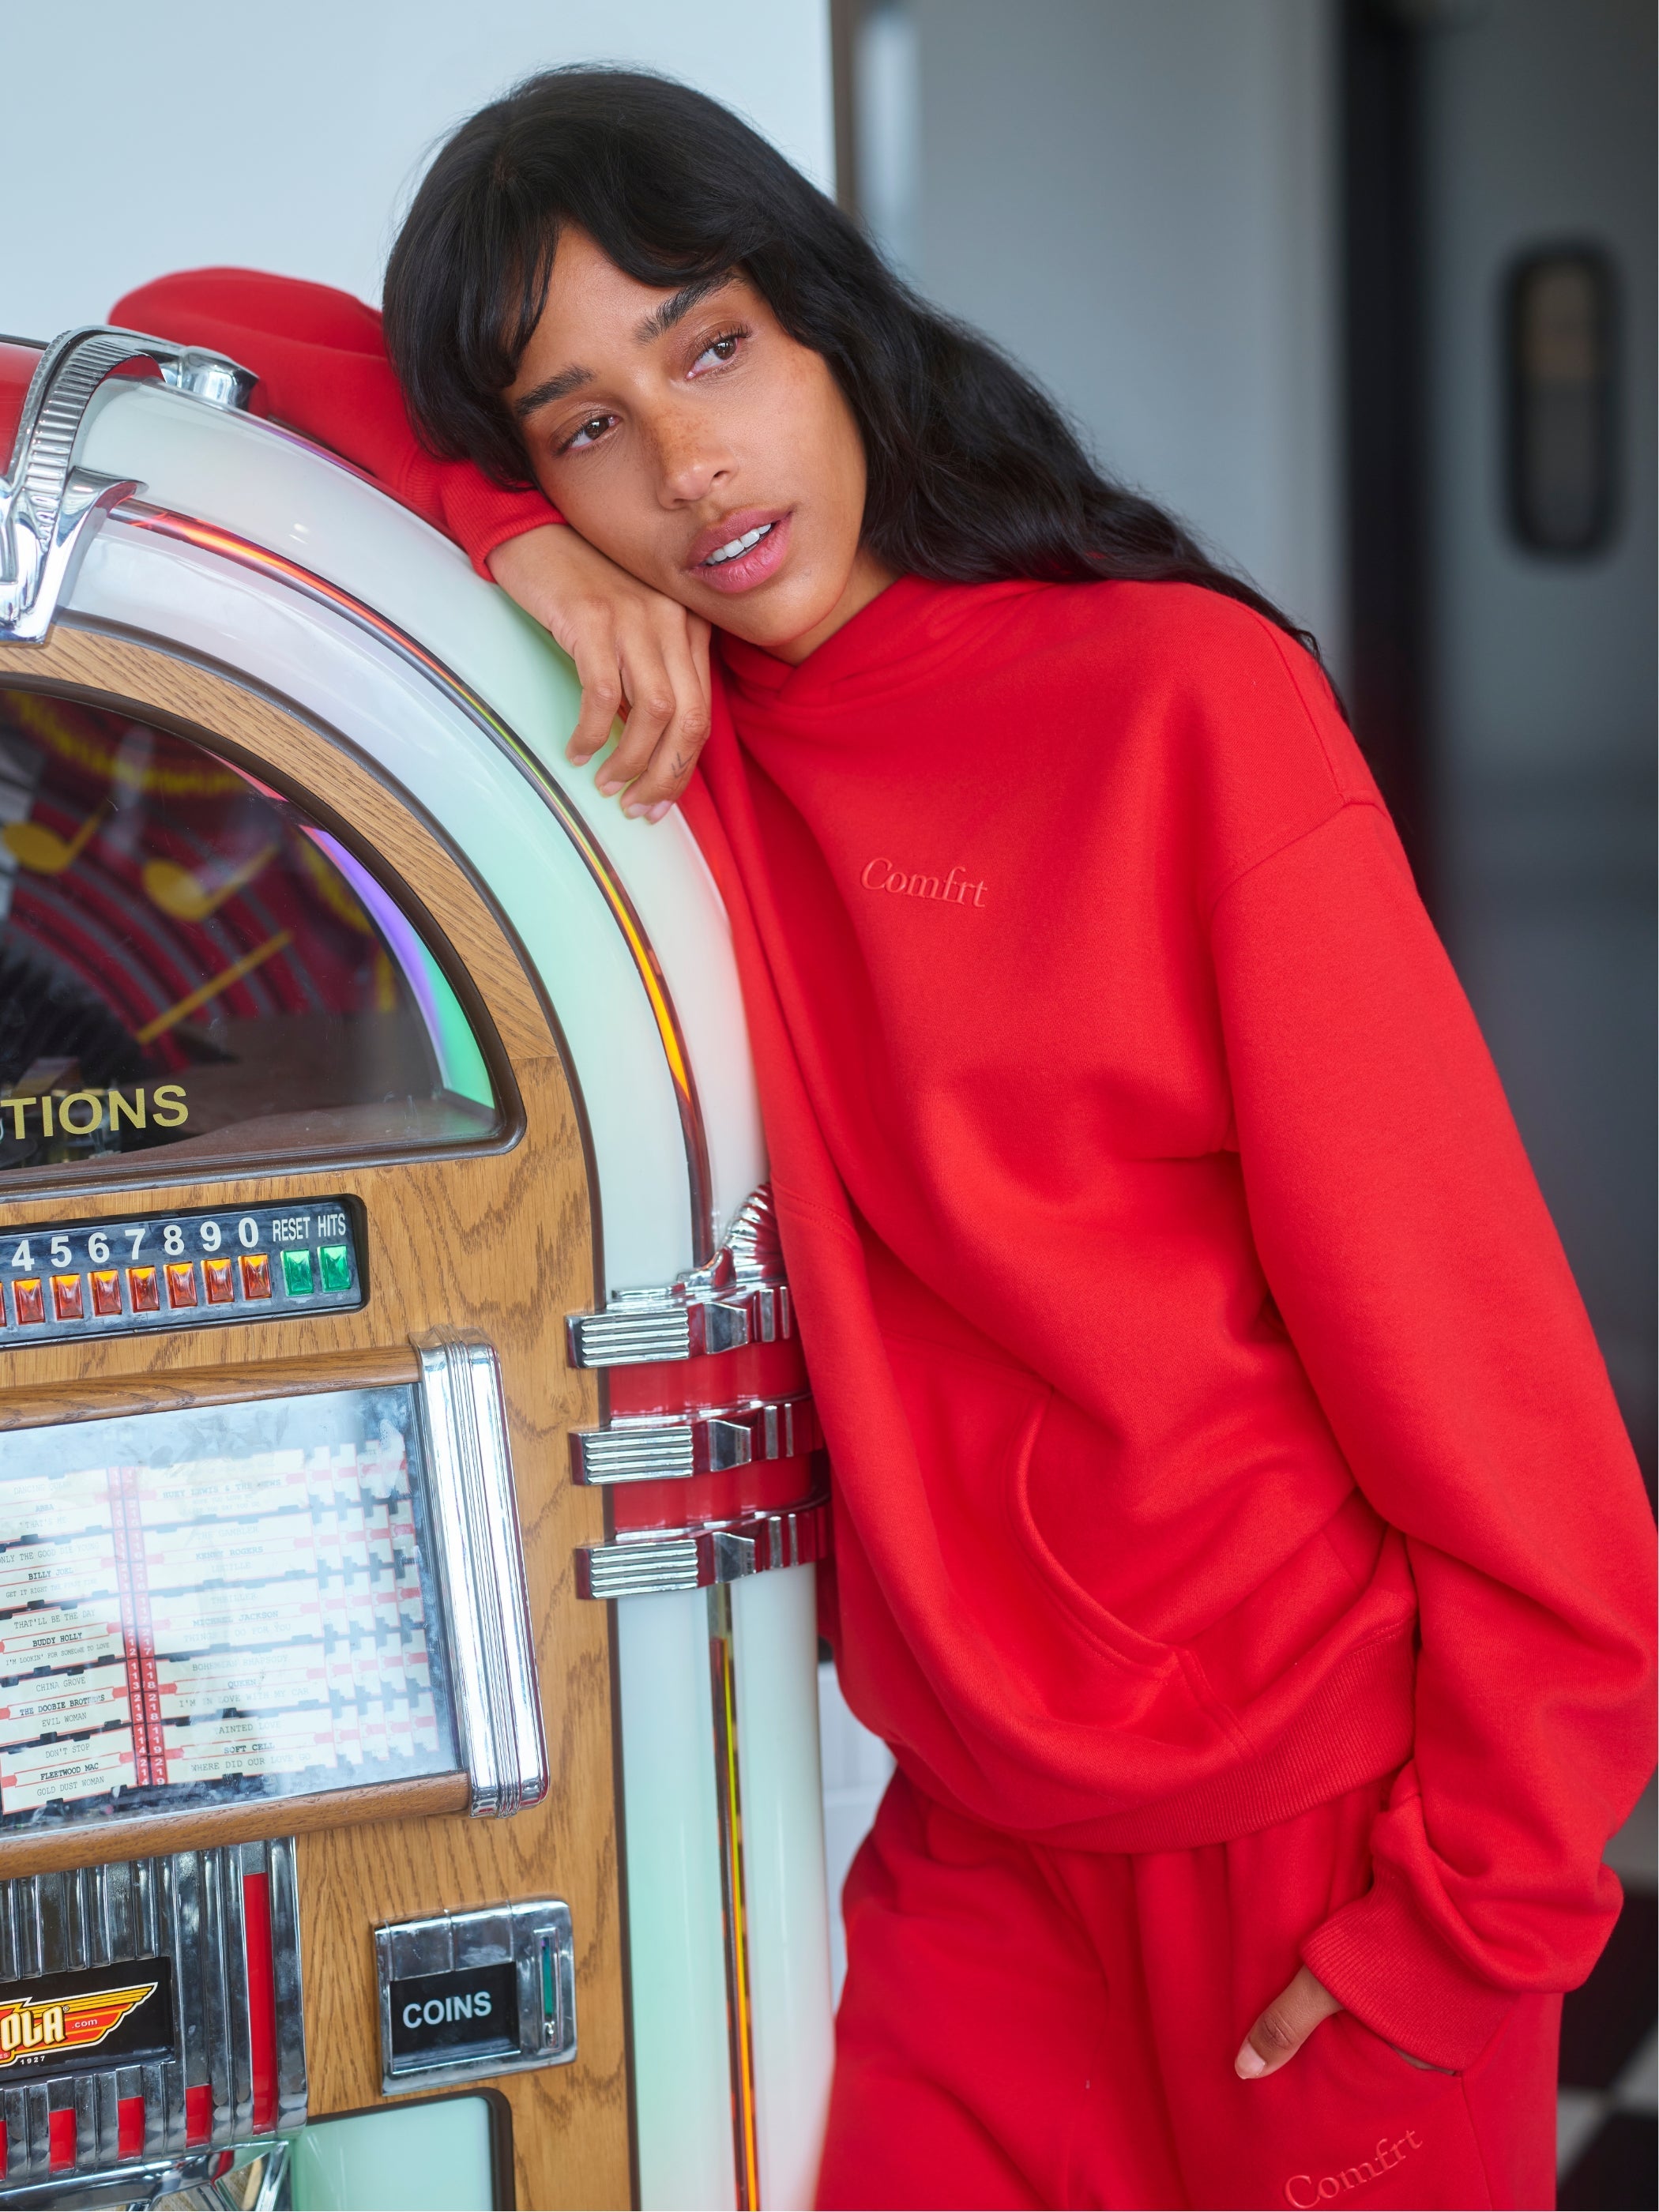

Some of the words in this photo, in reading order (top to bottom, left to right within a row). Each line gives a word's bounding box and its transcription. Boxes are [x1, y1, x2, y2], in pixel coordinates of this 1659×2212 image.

[860, 857, 988, 908] Comfrt
[0, 1085, 189, 1139] TIONS
[11, 1240, 35, 1271] 4
[51, 1236, 72, 1267] 5
[88, 1232, 110, 1263] 6
[124, 1228, 145, 1260] 7
[164, 1224, 185, 1255] 8
[200, 1221, 221, 1251] 9
[239, 1217, 258, 1247] 0
[273, 1217, 310, 1242] RESET
[318, 1213, 346, 1237] HITS
[0, 1555, 15, 1564] NLY
[19, 1552, 34, 1561] THE
[37, 1548, 56, 1559] GOOD
[229, 1546, 264, 1556] ROGERS
[28, 1571, 51, 1581] BILLY
[30, 1586, 48, 1594] RIGHT
[13, 1618, 47, 1629] THAT'LL
[51, 1614, 62, 1623] BE
[63, 1612, 79, 1621] THE
[239, 1610, 279, 1622] JACKSON
[32, 1637, 56, 1647] BUDDY
[60, 1632, 83, 1642] HOLLY
[36, 1681, 60, 1691] CHINA
[63, 1676, 86, 1687] GROVE
[20, 1707, 34, 1717] THE
[38, 1701, 66, 1713] DOOBIE
[70, 1694, 105, 1706] BROT'S
[42, 1717, 61, 1727] EVIL
[64, 1712, 88, 1723] WOMAN
[45, 1747, 68, 1759] DON'T
[72, 1743, 91, 1753] STOP
[224, 1745, 246, 1755] SOFT
[251, 1742, 275, 1751] CELL
[225, 1759, 243, 1769] DID
[247, 1757, 266, 1766] OUR
[40, 1766, 81, 1781] FLEETWOOD
[85, 1762, 100, 1772] MAC
[36, 1786, 56, 1796] GOLD
[59, 1781, 77, 1792] DUST
[81, 1776, 105, 1787] WOMAN
[402, 1991, 492, 2029] COINS
[71, 2018, 98, 2029] .com
[20, 2055, 46, 2065] 1927
[1285, 2130, 1423, 2209] Comfrt
